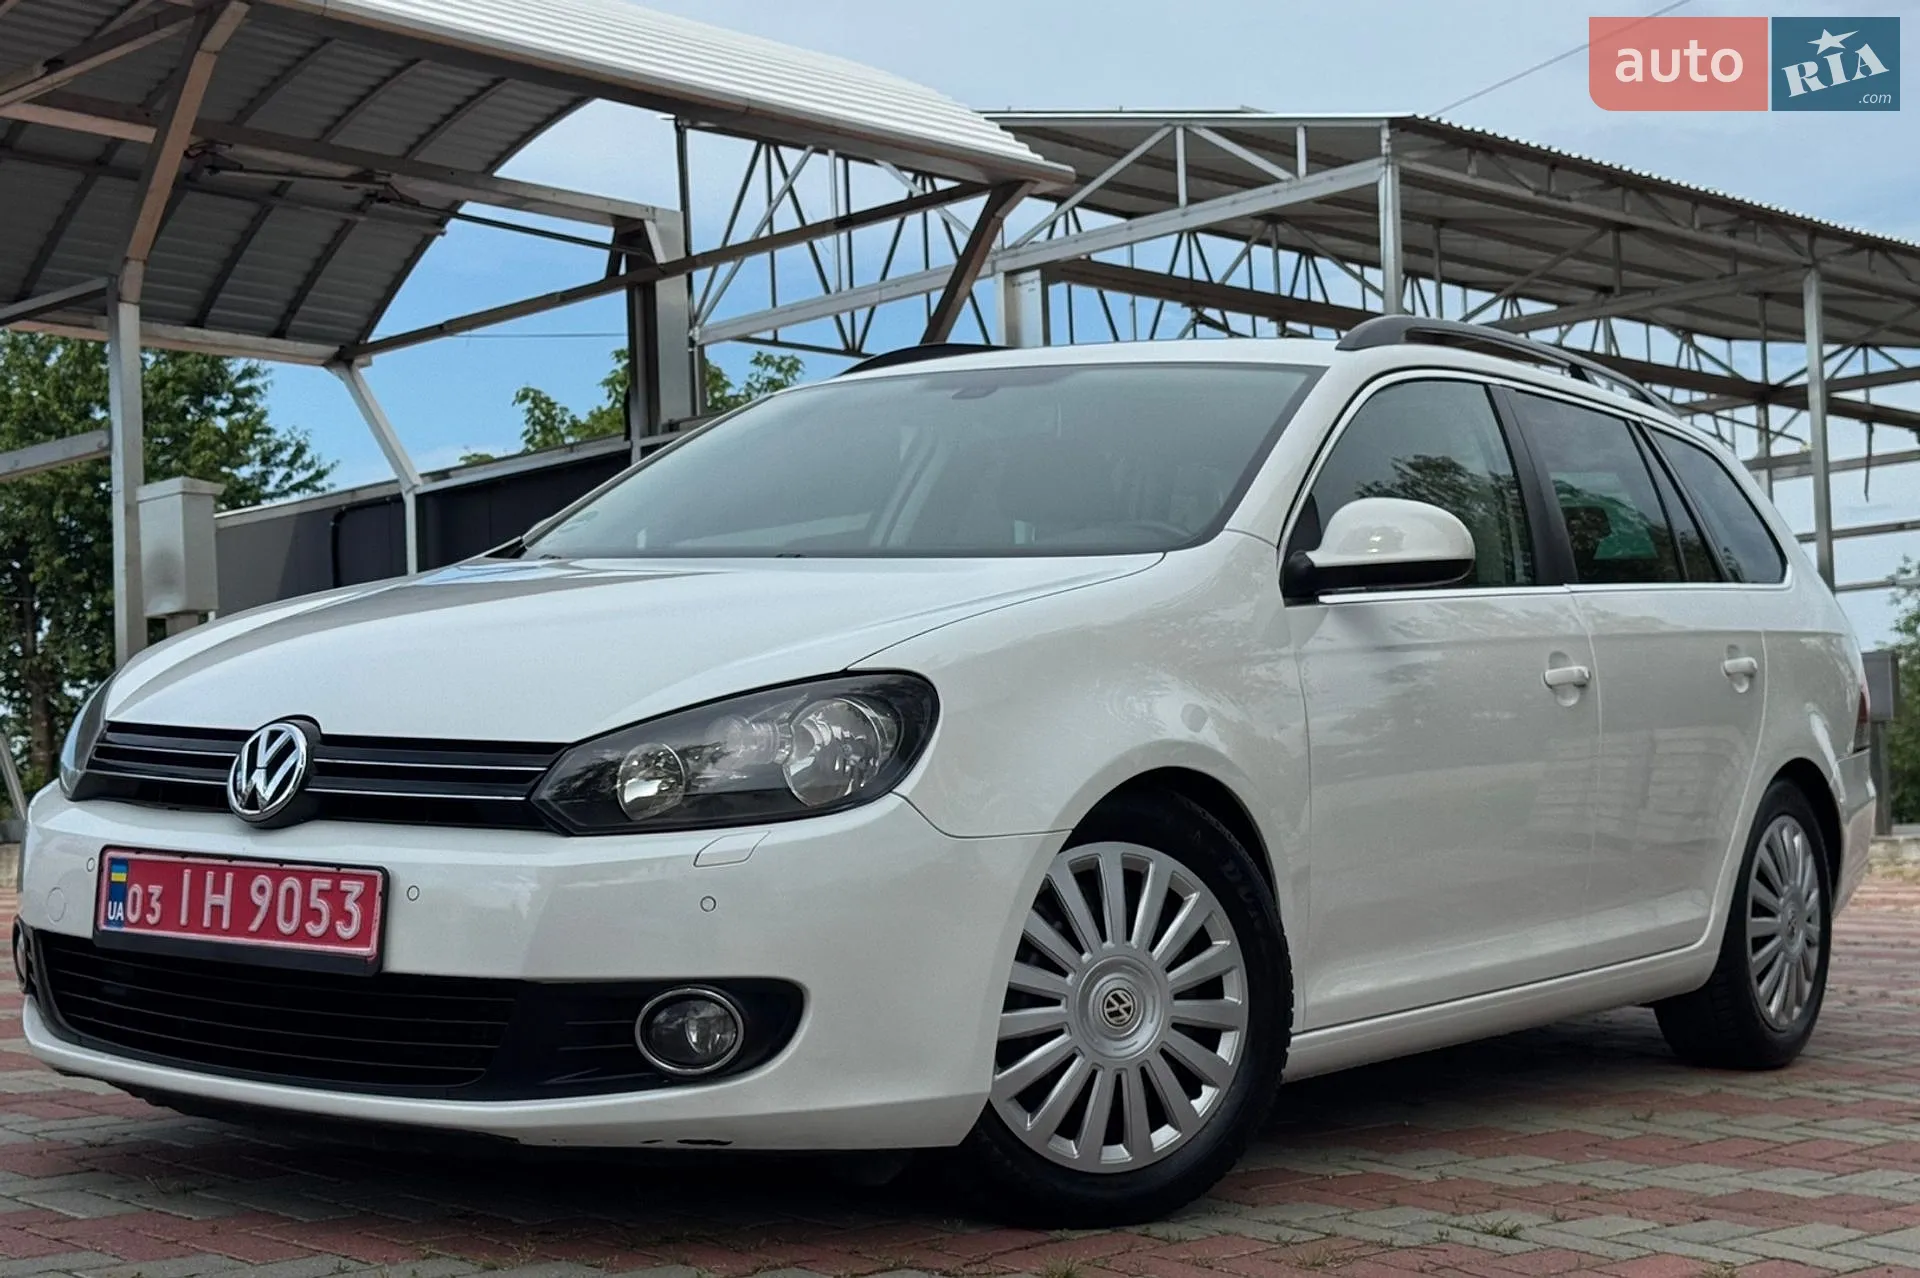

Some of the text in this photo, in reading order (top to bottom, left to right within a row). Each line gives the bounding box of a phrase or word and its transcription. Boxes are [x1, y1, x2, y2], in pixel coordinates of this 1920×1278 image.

[107, 900, 125, 921] UA
[126, 868, 366, 941] 03 IH 9053
